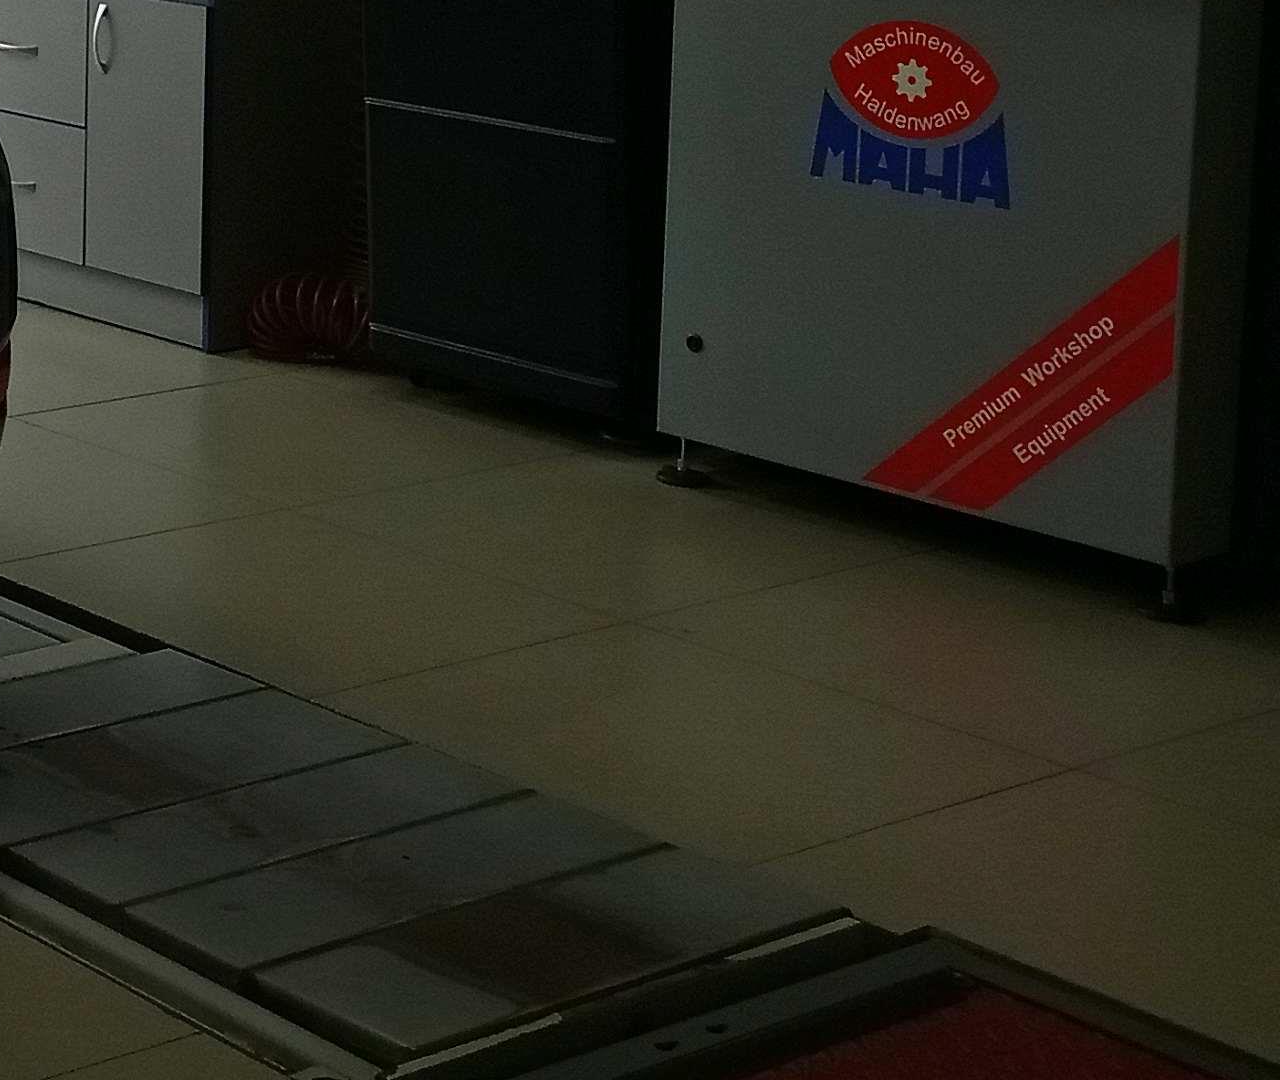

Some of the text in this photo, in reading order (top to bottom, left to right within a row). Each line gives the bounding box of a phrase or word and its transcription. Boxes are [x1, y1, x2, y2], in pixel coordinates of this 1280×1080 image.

[844, 26, 986, 87] Maschinenbau
[854, 82, 971, 132] Haldenwang
[810, 88, 1011, 210] MAHA
[942, 316, 1115, 448] Premium Workshop
[1012, 386, 1112, 464] Equipment
